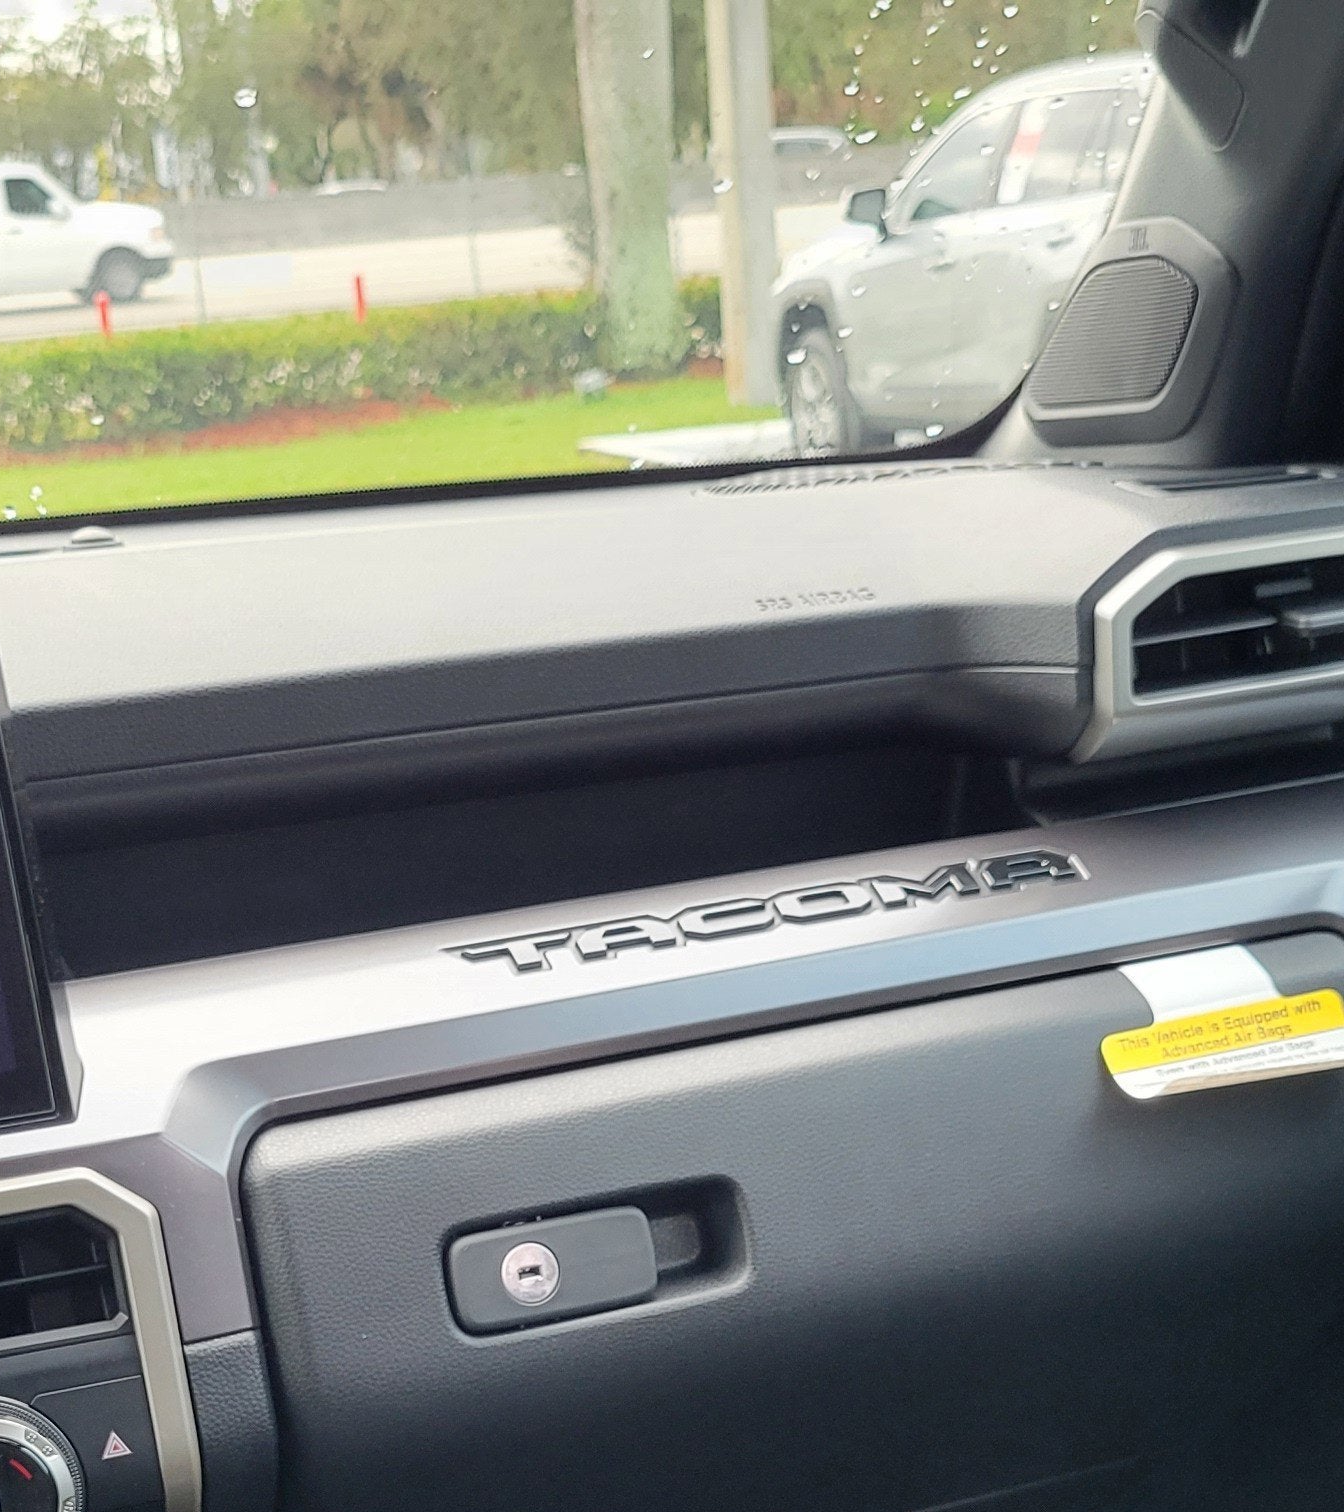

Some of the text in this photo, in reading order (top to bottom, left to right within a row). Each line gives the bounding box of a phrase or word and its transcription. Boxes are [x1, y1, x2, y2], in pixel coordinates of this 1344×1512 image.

[439, 849, 1091, 973] TACOMA
[1119, 1037, 1149, 1052] This
[1224, 1008, 1288, 1030] Equipped
[1295, 1000, 1322, 1016] with
[1162, 1023, 1293, 1059] Advanced Air Bags
